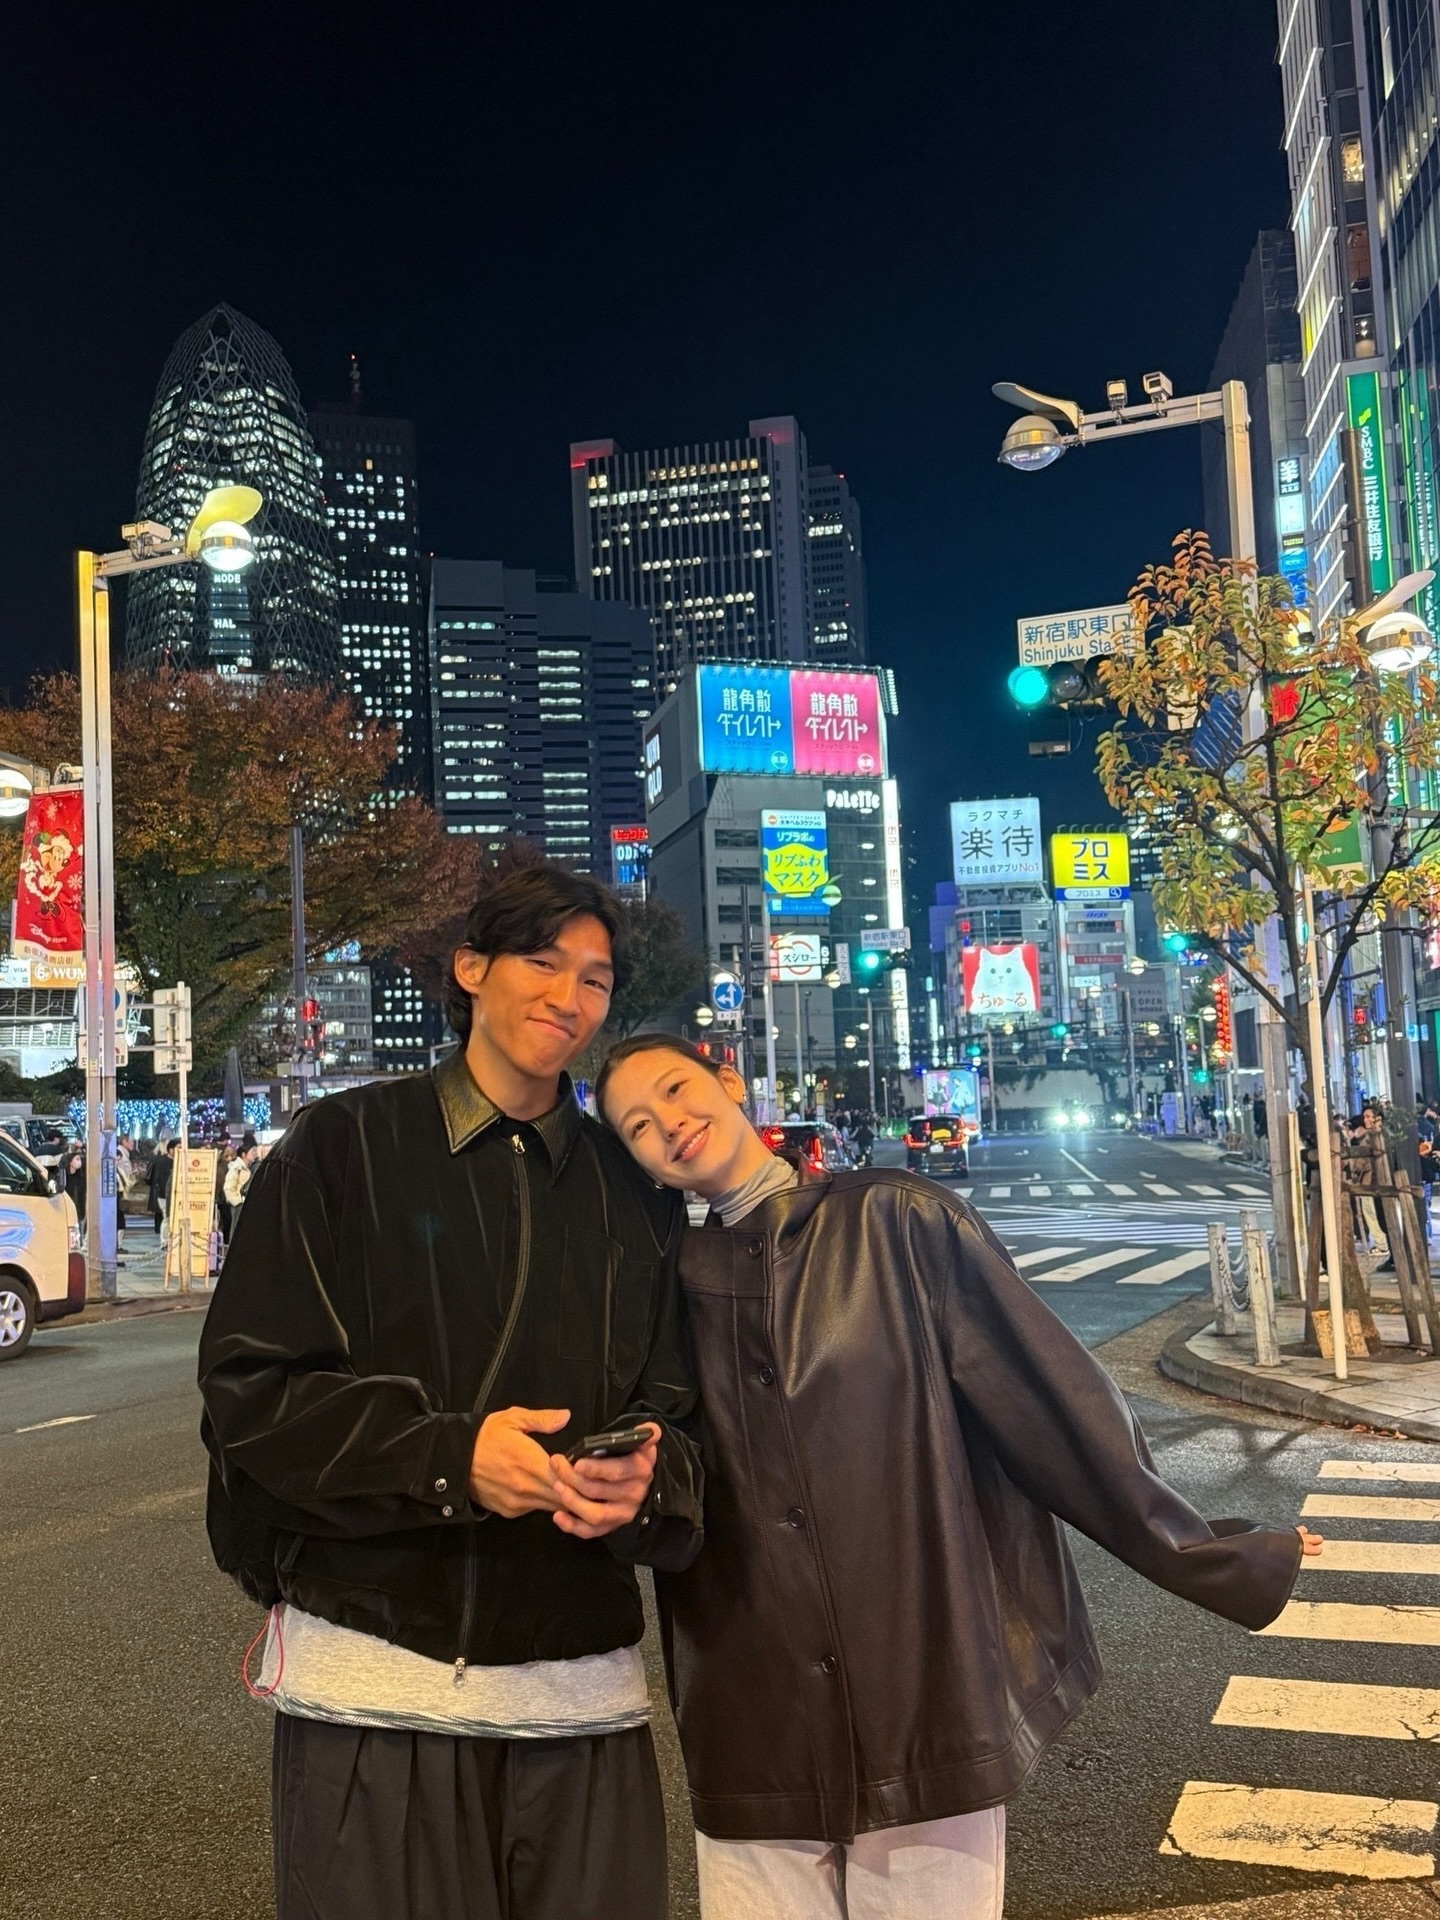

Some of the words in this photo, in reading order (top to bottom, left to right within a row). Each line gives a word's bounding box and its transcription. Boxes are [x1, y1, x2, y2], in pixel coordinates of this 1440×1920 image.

[1361, 425, 1373, 470] SMBC
[1363, 475, 1384, 562] 三井住友銀行
[213, 573, 241, 583] MODE
[213, 618, 237, 629] HAL
[1023, 612, 1132, 646] 新宿駅東口
[1023, 643, 1084, 664] Shinjuku
[722, 687, 772, 713] 龍角散
[810, 691, 859, 718] 龍角散
[716, 713, 782, 739] ダイレクト
[804, 717, 868, 743] ダイレクト
[968, 809, 1023, 822] ラクマチ
[960, 825, 1034, 860] 楽待
[1071, 838, 1109, 859] プロ
[774, 853, 821, 868] リブふわ
[774, 871, 820, 888] マスク
[1073, 863, 1111, 881] ミス
[1075, 890, 1102, 898] プロミス
[783, 953, 817, 963] スシロー
